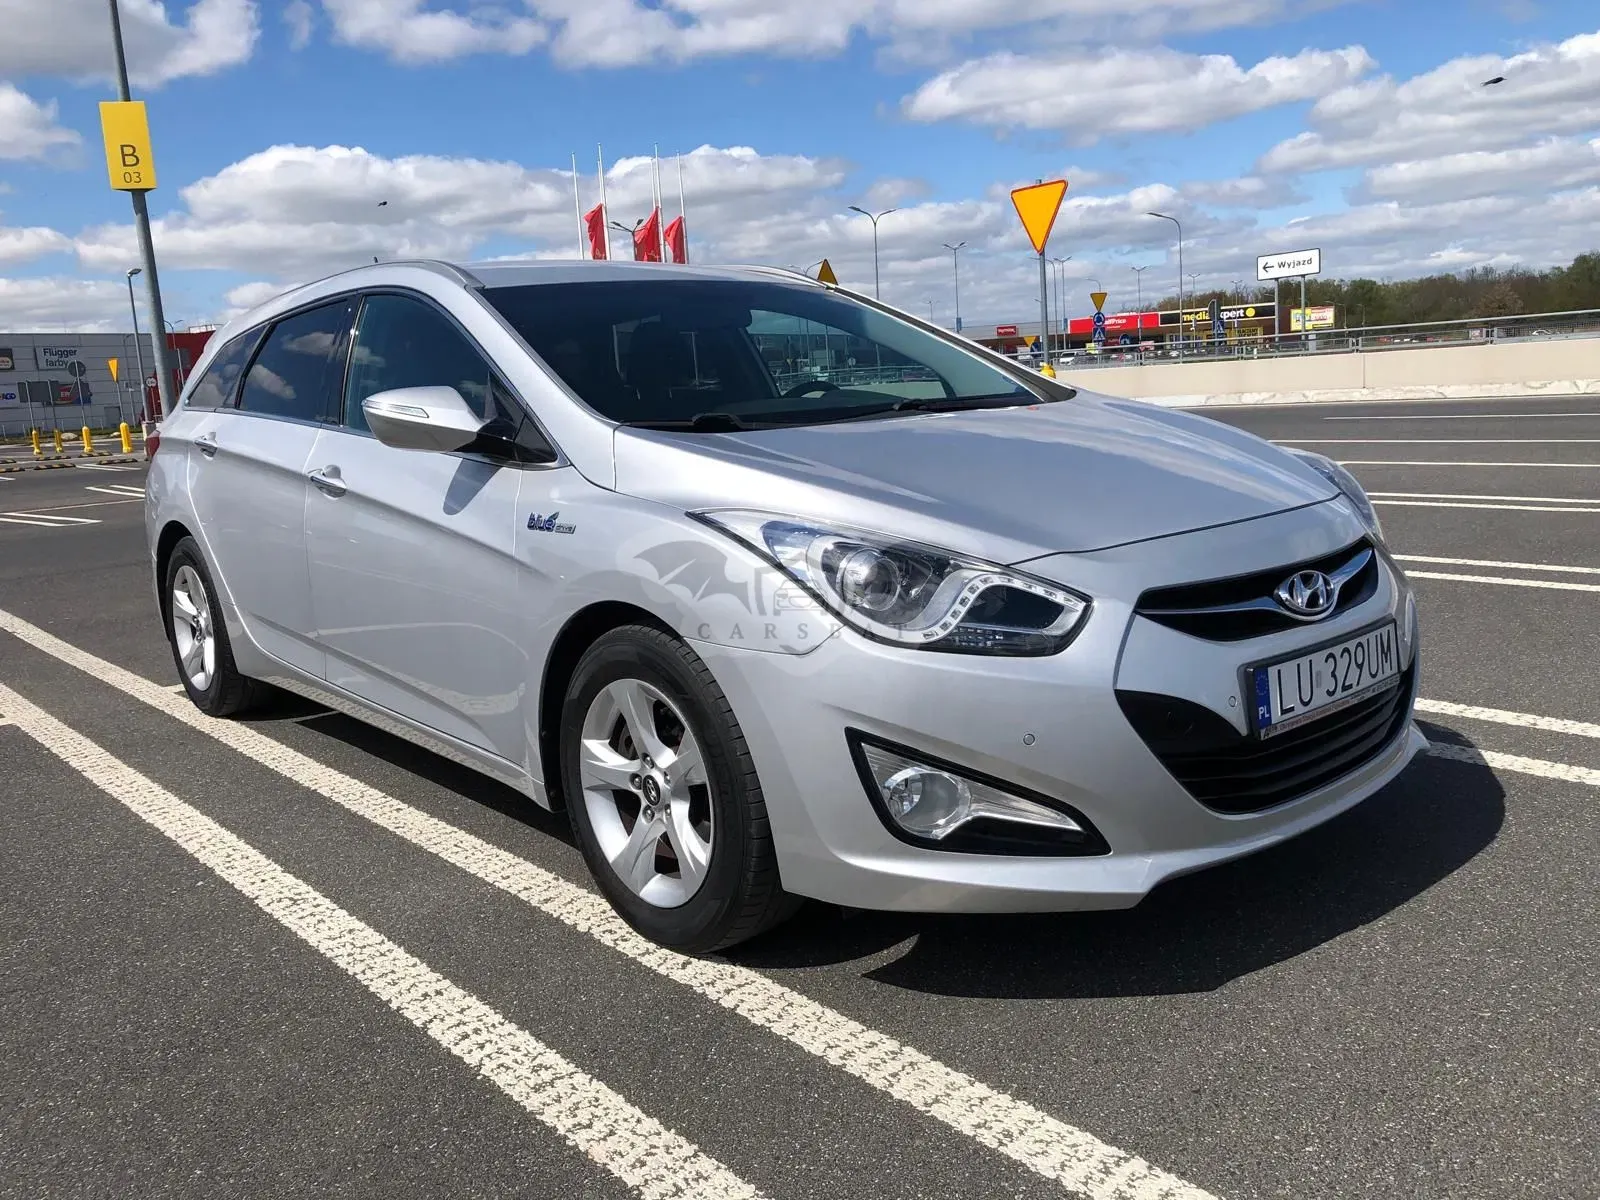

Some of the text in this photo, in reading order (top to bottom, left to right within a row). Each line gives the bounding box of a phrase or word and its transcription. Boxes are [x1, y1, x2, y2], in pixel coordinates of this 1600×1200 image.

[120, 144, 140, 167] B
[123, 171, 142, 183] 03
[1277, 257, 1313, 269] Wyjazd
[1219, 307, 1244, 319] xpert
[43, 348, 77, 358] Flügger
[1277, 629, 1393, 717] LU 329UM
[1258, 705, 1270, 720] PL
